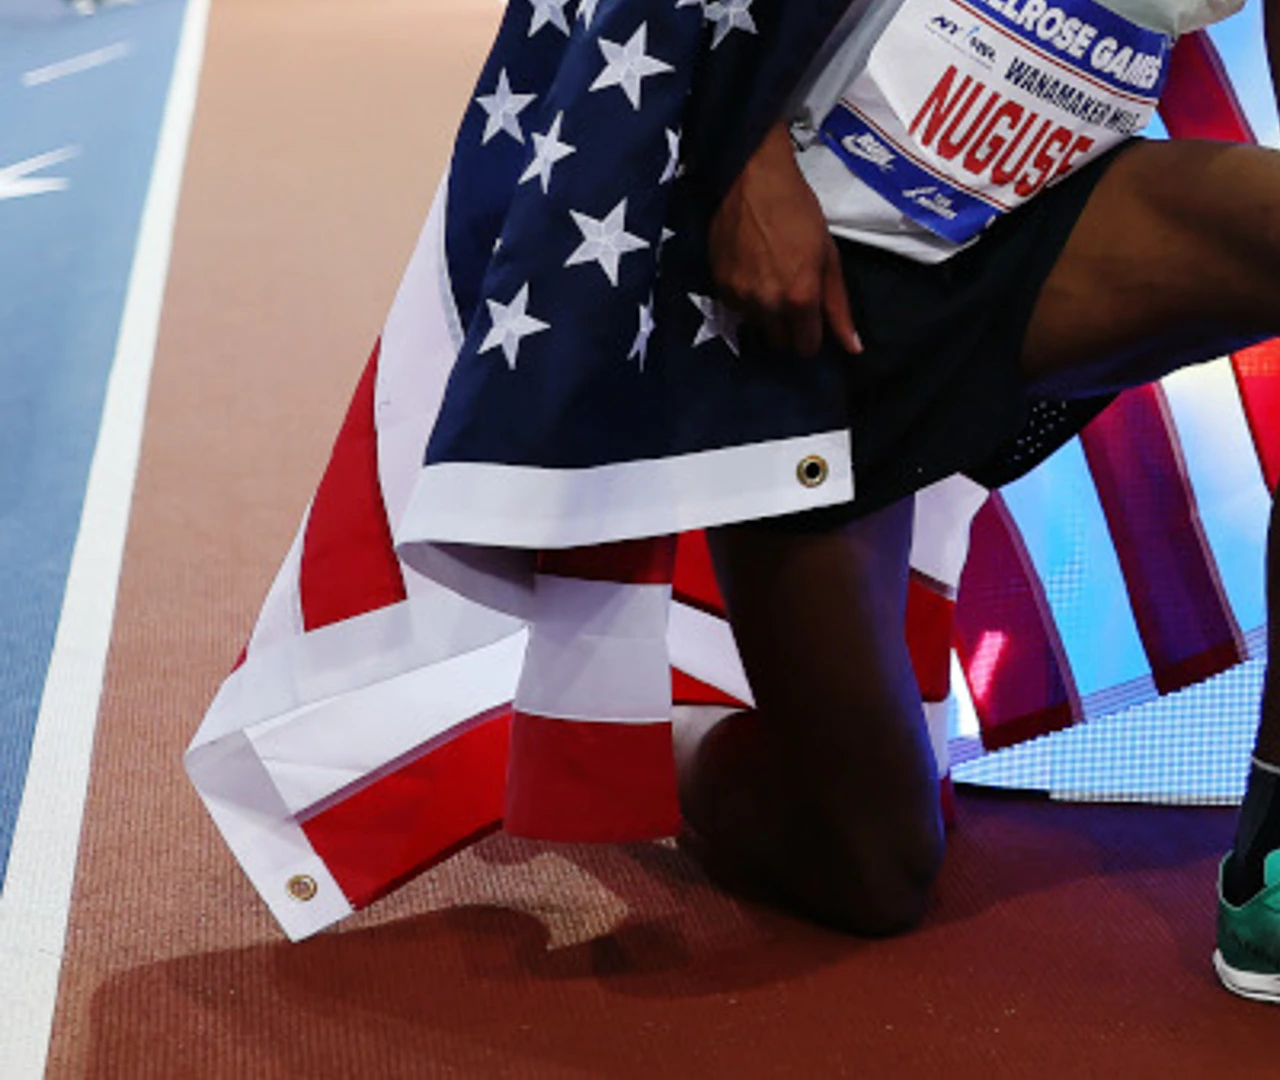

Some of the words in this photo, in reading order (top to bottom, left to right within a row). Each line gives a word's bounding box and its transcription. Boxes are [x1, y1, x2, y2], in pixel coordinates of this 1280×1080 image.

[1003, 56, 1113, 127] WANAMAKER
[1090, 36, 1163, 90] GAMES
[907, 64, 1096, 197] NUGUSE
